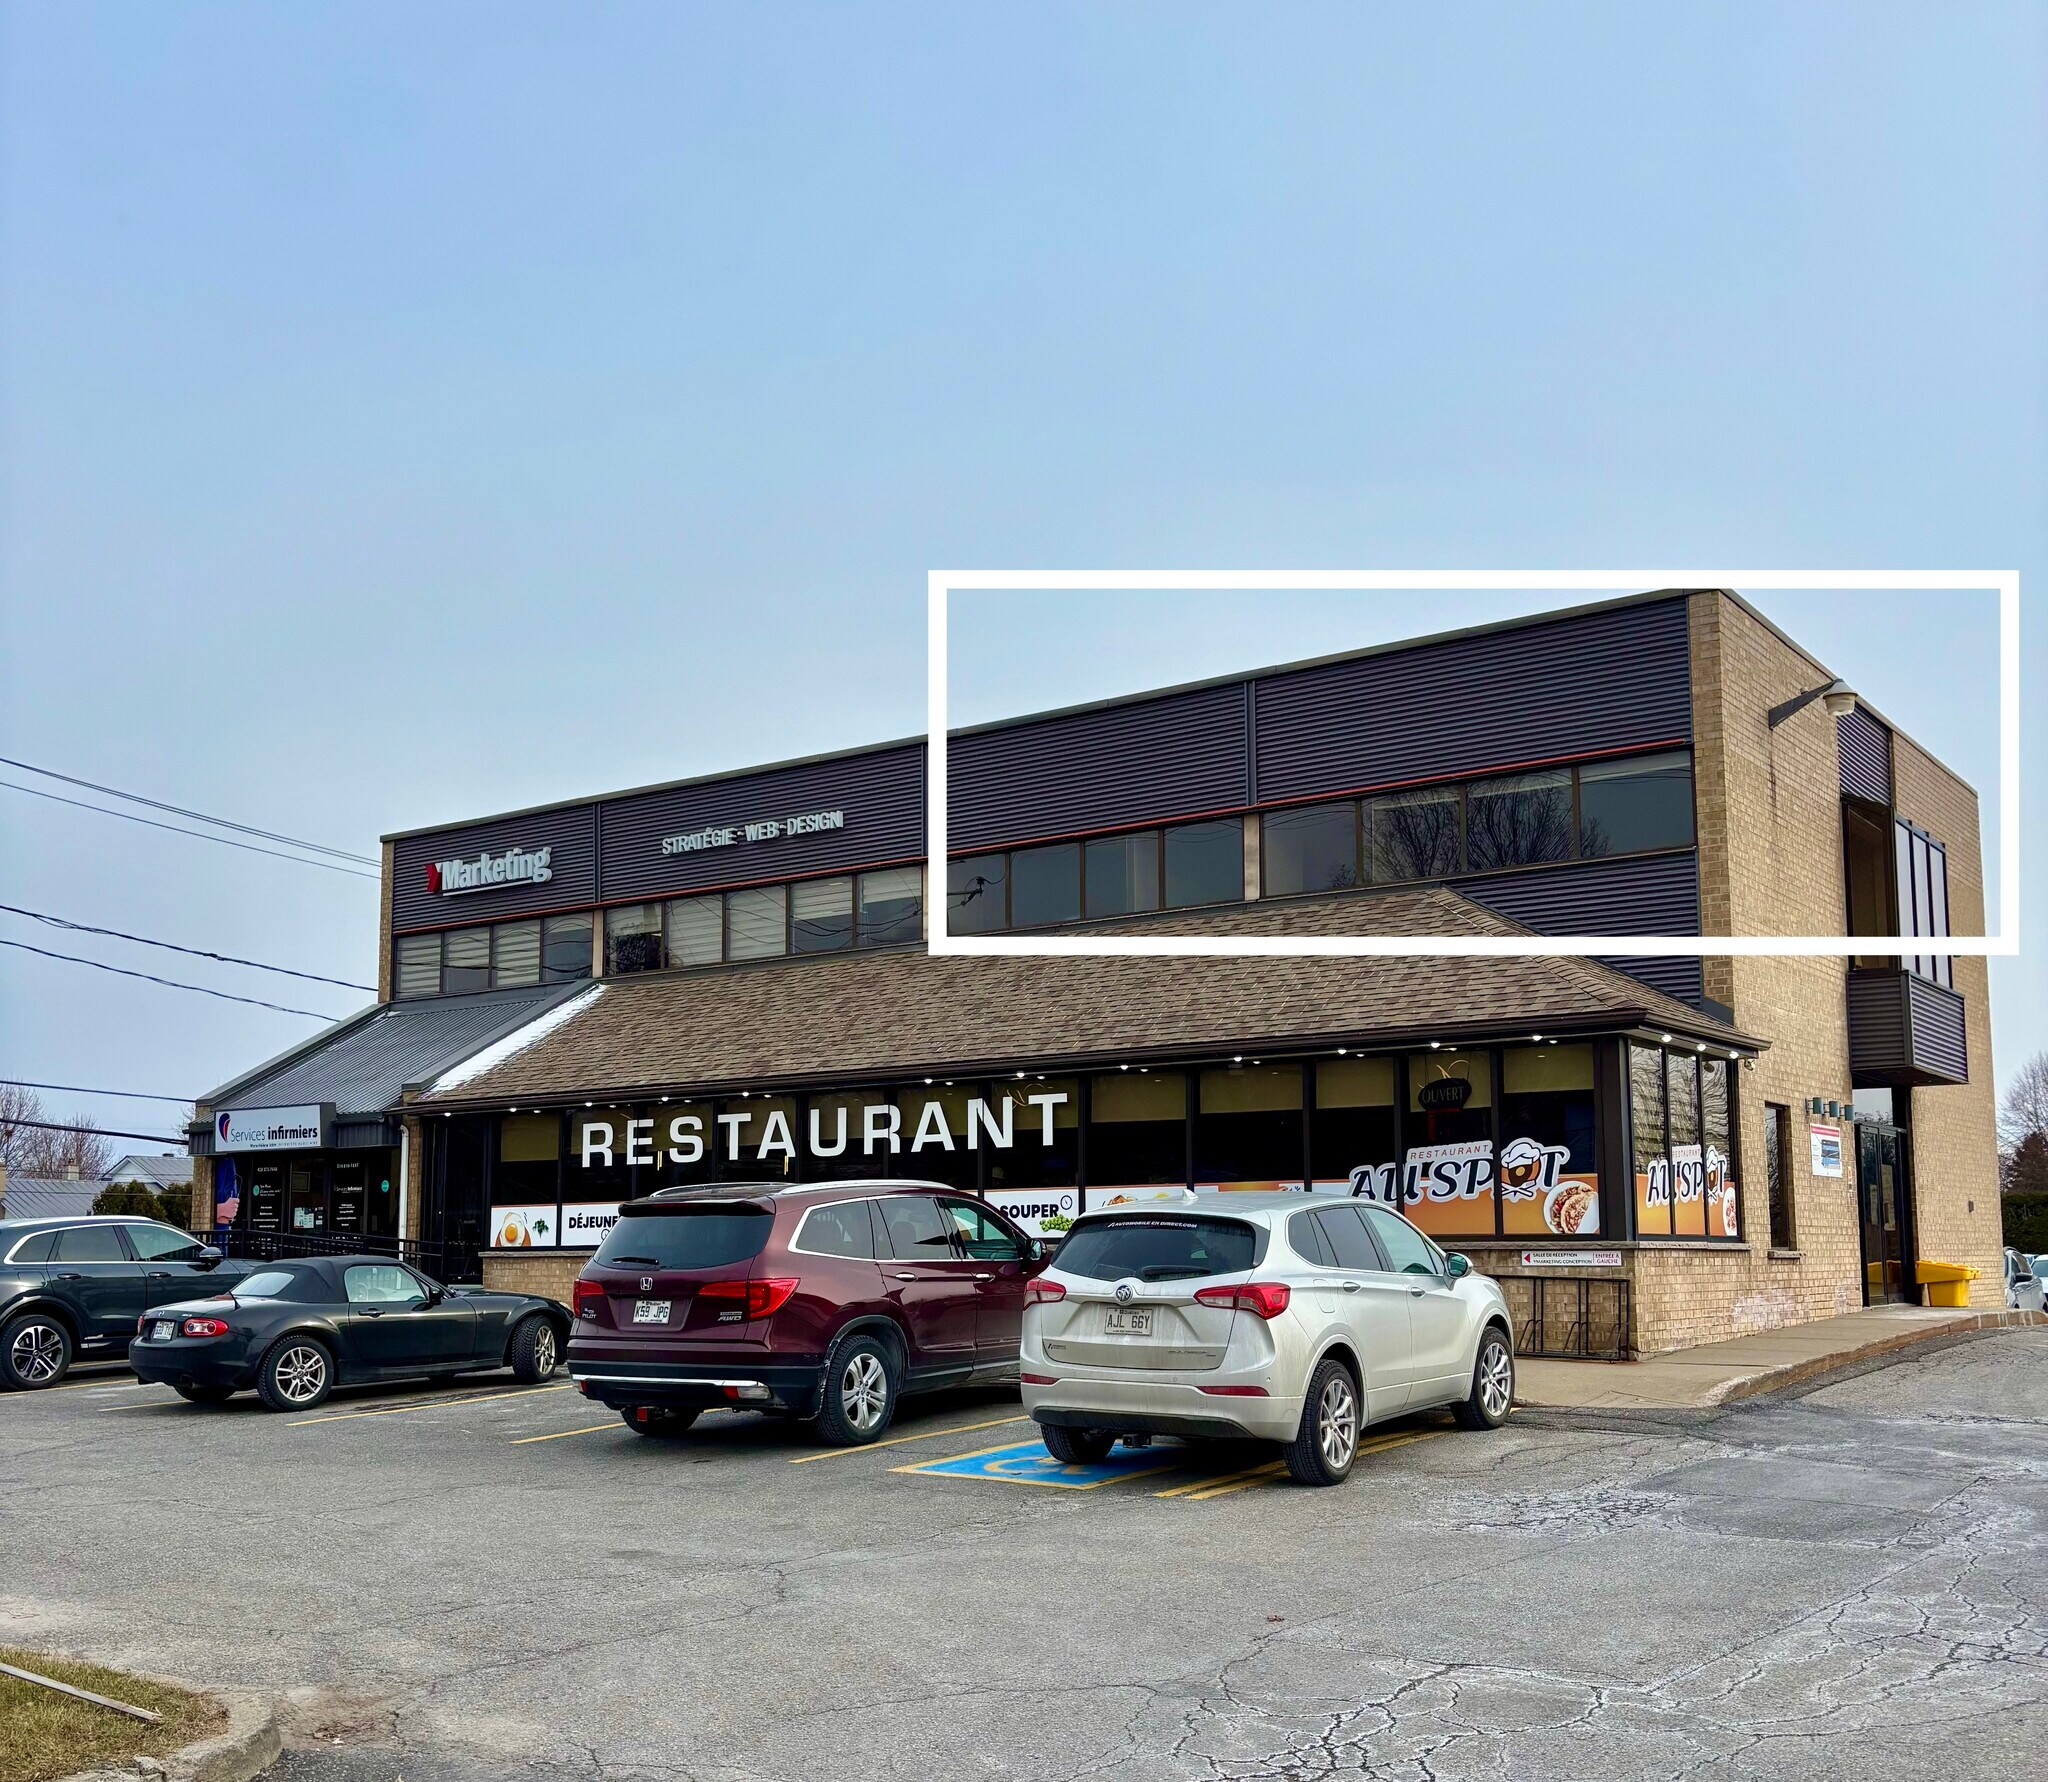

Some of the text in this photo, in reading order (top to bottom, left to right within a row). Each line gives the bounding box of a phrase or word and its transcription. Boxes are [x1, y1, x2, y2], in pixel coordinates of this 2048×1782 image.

[745, 821, 780, 841] WEB
[786, 811, 844, 836] DESIGN
[1422, 1086, 1464, 1104] OUVERT
[230, 1125, 318, 1142] Services infirmiers
[581, 1093, 1068, 1168] RESTAURANT
[1410, 1144, 1490, 1160] RESTAURANT
[999, 1203, 1060, 1219] SOUPER
[634, 1306, 669, 1319] K59 JPG
[1107, 1314, 1151, 1329] AJL 66Y
